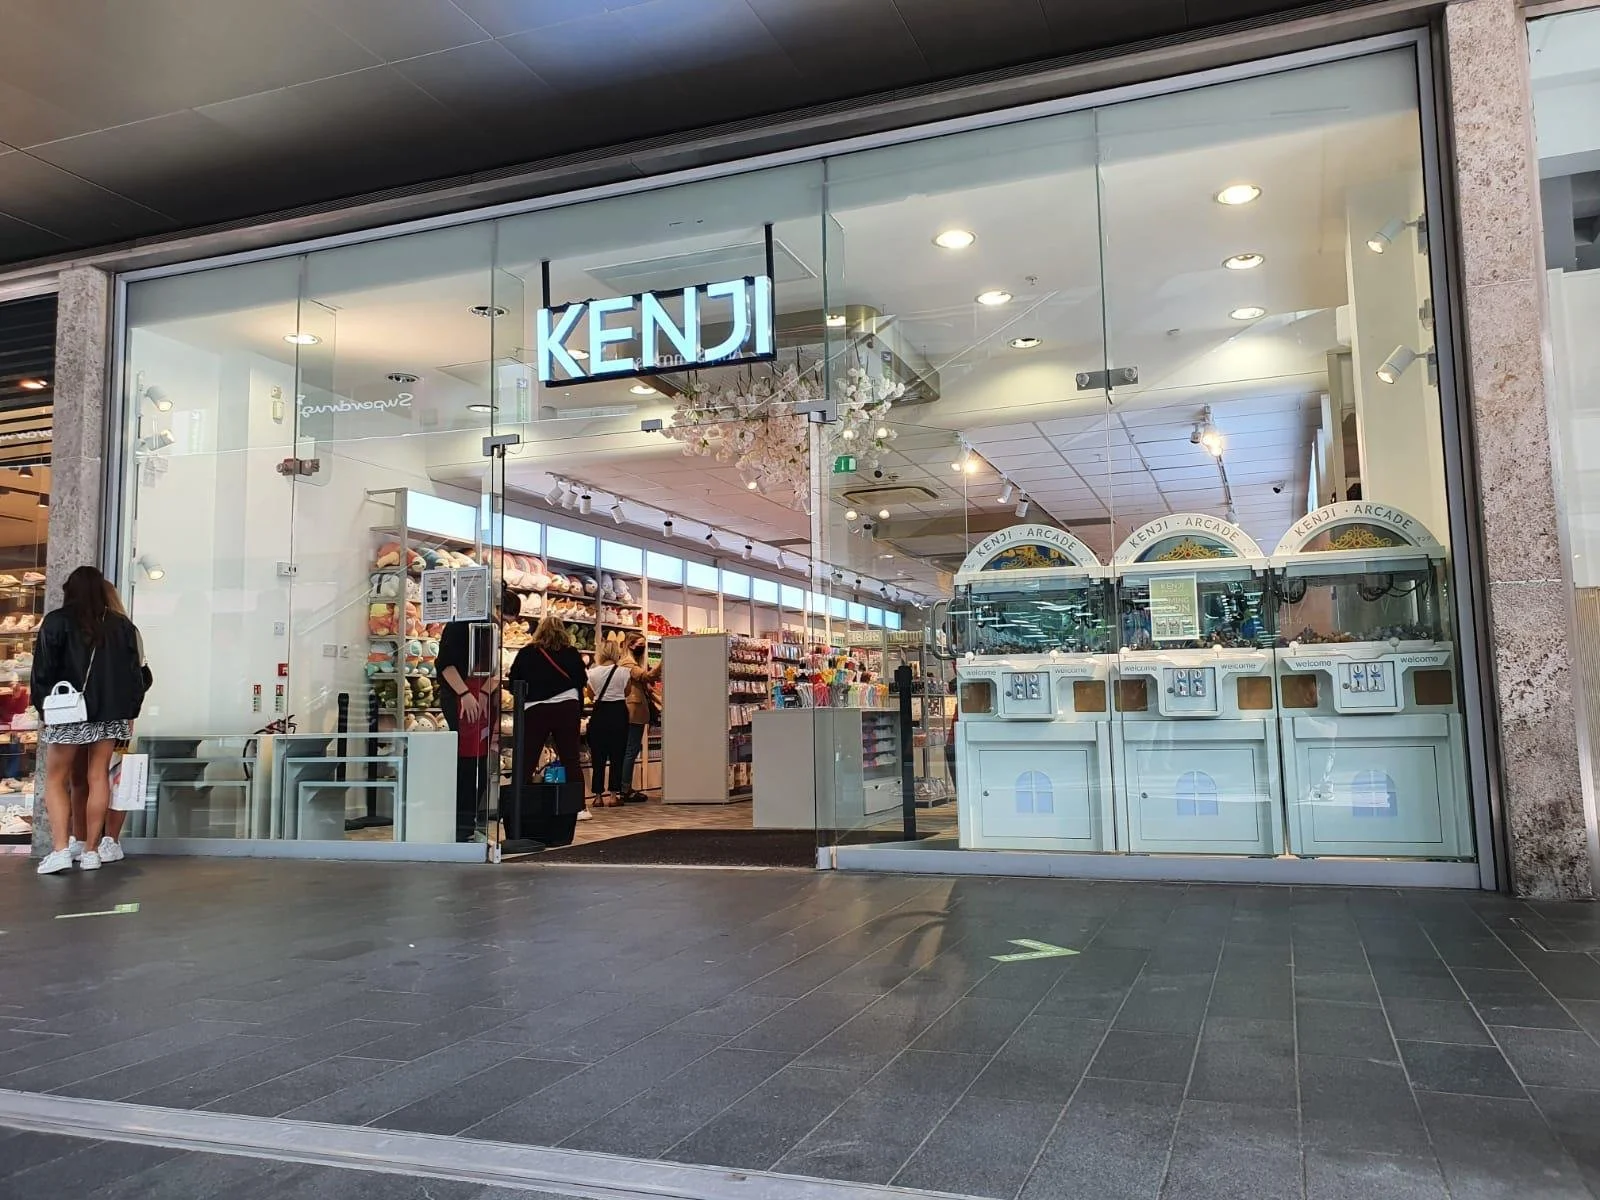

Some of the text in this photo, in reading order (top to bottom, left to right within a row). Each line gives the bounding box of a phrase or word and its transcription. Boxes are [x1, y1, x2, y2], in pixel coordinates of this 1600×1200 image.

[536, 275, 772, 382] KENJI
[1129, 517, 1240, 549] KENJI ARCADE
[1294, 504, 1413, 537] KENJI ARCADE
[976, 528, 1077, 557] KENJI ARCADE
[1221, 662, 1257, 670] welcome
[1295, 660, 1332, 668] welcome
[1400, 655, 1439, 664] welcome
